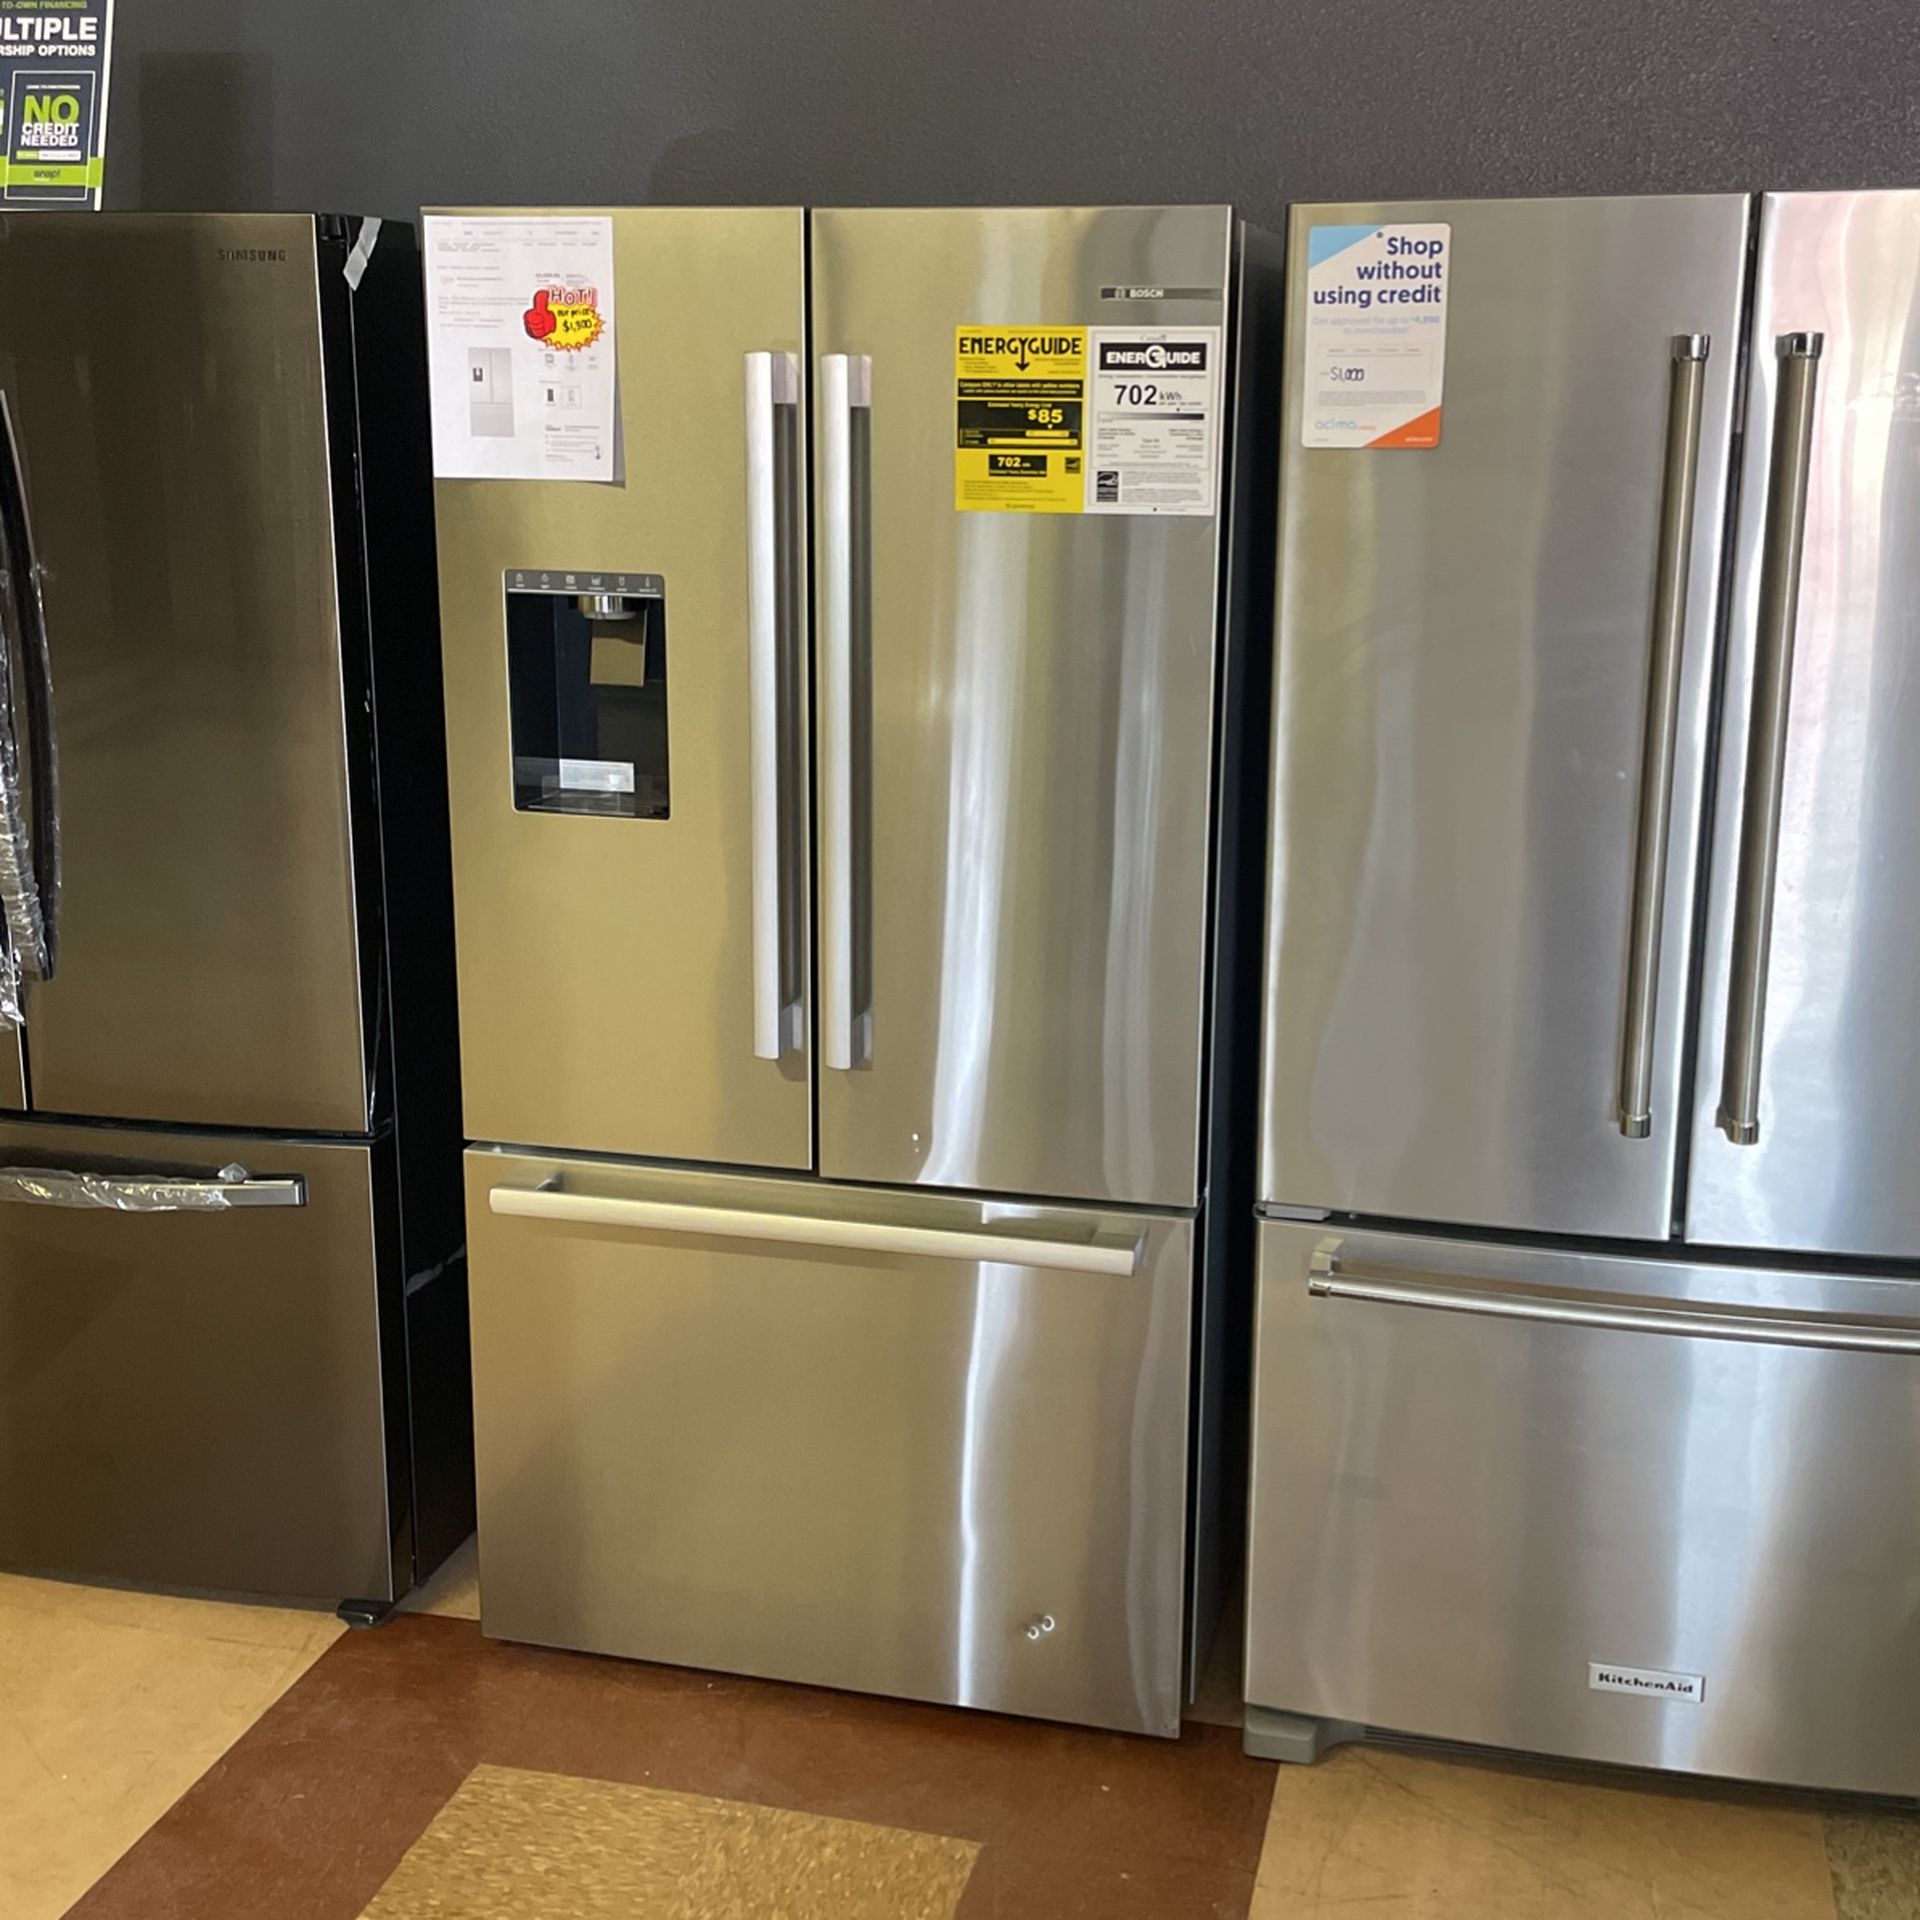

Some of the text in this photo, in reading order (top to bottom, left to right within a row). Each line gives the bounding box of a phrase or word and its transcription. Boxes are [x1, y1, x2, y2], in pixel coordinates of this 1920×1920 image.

[0, 16, 98, 41] LTIPLE
[38, 44, 96, 57] OPTIONS
[23, 94, 80, 124] NO
[22, 122, 80, 136] CREDIT
[20, 134, 79, 147] NEEDED
[217, 248, 287, 262] SAMSUNG
[1387, 236, 1444, 259] Shop
[1356, 260, 1443, 280] without
[1129, 288, 1165, 298] BOSCH
[1313, 284, 1442, 309] using credit
[1114, 384, 1158, 406] 702
[1027, 408, 1064, 424] $85
[997, 456, 1022, 468] 702
[1598, 1672, 1694, 1693] KitchenAid
